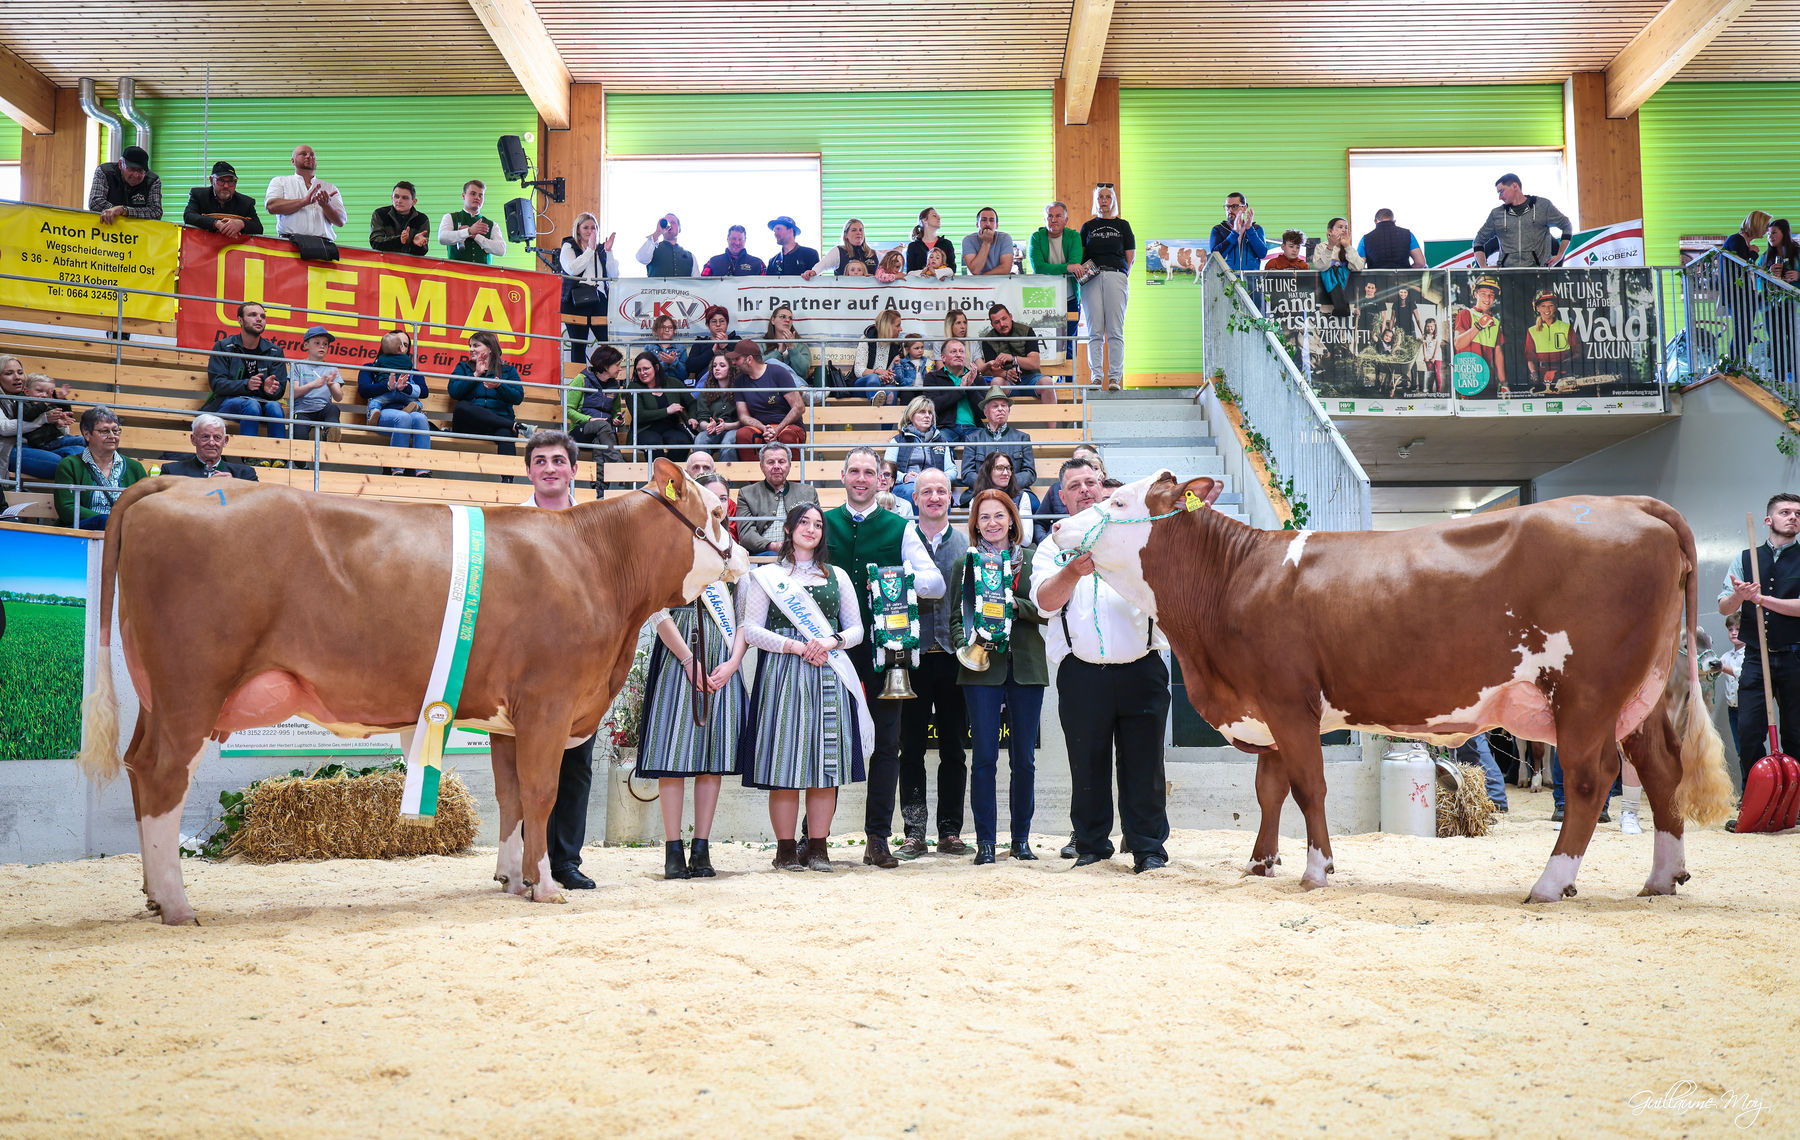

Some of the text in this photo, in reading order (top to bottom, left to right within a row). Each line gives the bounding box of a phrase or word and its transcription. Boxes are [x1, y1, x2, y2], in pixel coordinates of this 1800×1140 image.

[40, 221, 139, 245] Anton Puster
[46, 240, 132, 261] Wegscheiderweg 1
[1602, 250, 1638, 261] KOBENZ
[21, 252, 28, 262] S
[31, 253, 42, 263] 36
[53, 257, 88, 269] Abfahrt
[90, 261, 137, 273] Knittelfeld
[139, 265, 155, 275] Ost
[59, 272, 118, 287] 8723 Kobenz
[1256, 279, 1297, 292] MIT UNS
[47, 286, 129, 303] Tel: 0664 324593
[1553, 282, 1603, 301] MIT UNS
[244, 258, 516, 343] LEMA
[635, 301, 699, 317] LKV
[738, 295, 995, 314] Ihr Partner auf Augenhöhe
[1587, 299, 1600, 307] HAT
[1558, 305, 1649, 342] Wald
[1320, 330, 1371, 344] ZUKUNFT!
[433, 351, 454, 366] für
[1586, 341, 1648, 359] ZUKUNFT!
[1455, 364, 1483, 373] JUGEND
[1458, 379, 1479, 388] LAND
[1571, 505, 1592, 524] 2
[472, 552, 482, 565] VZG
[468, 565, 481, 596] Knittelfeld
[463, 607, 476, 625] April
